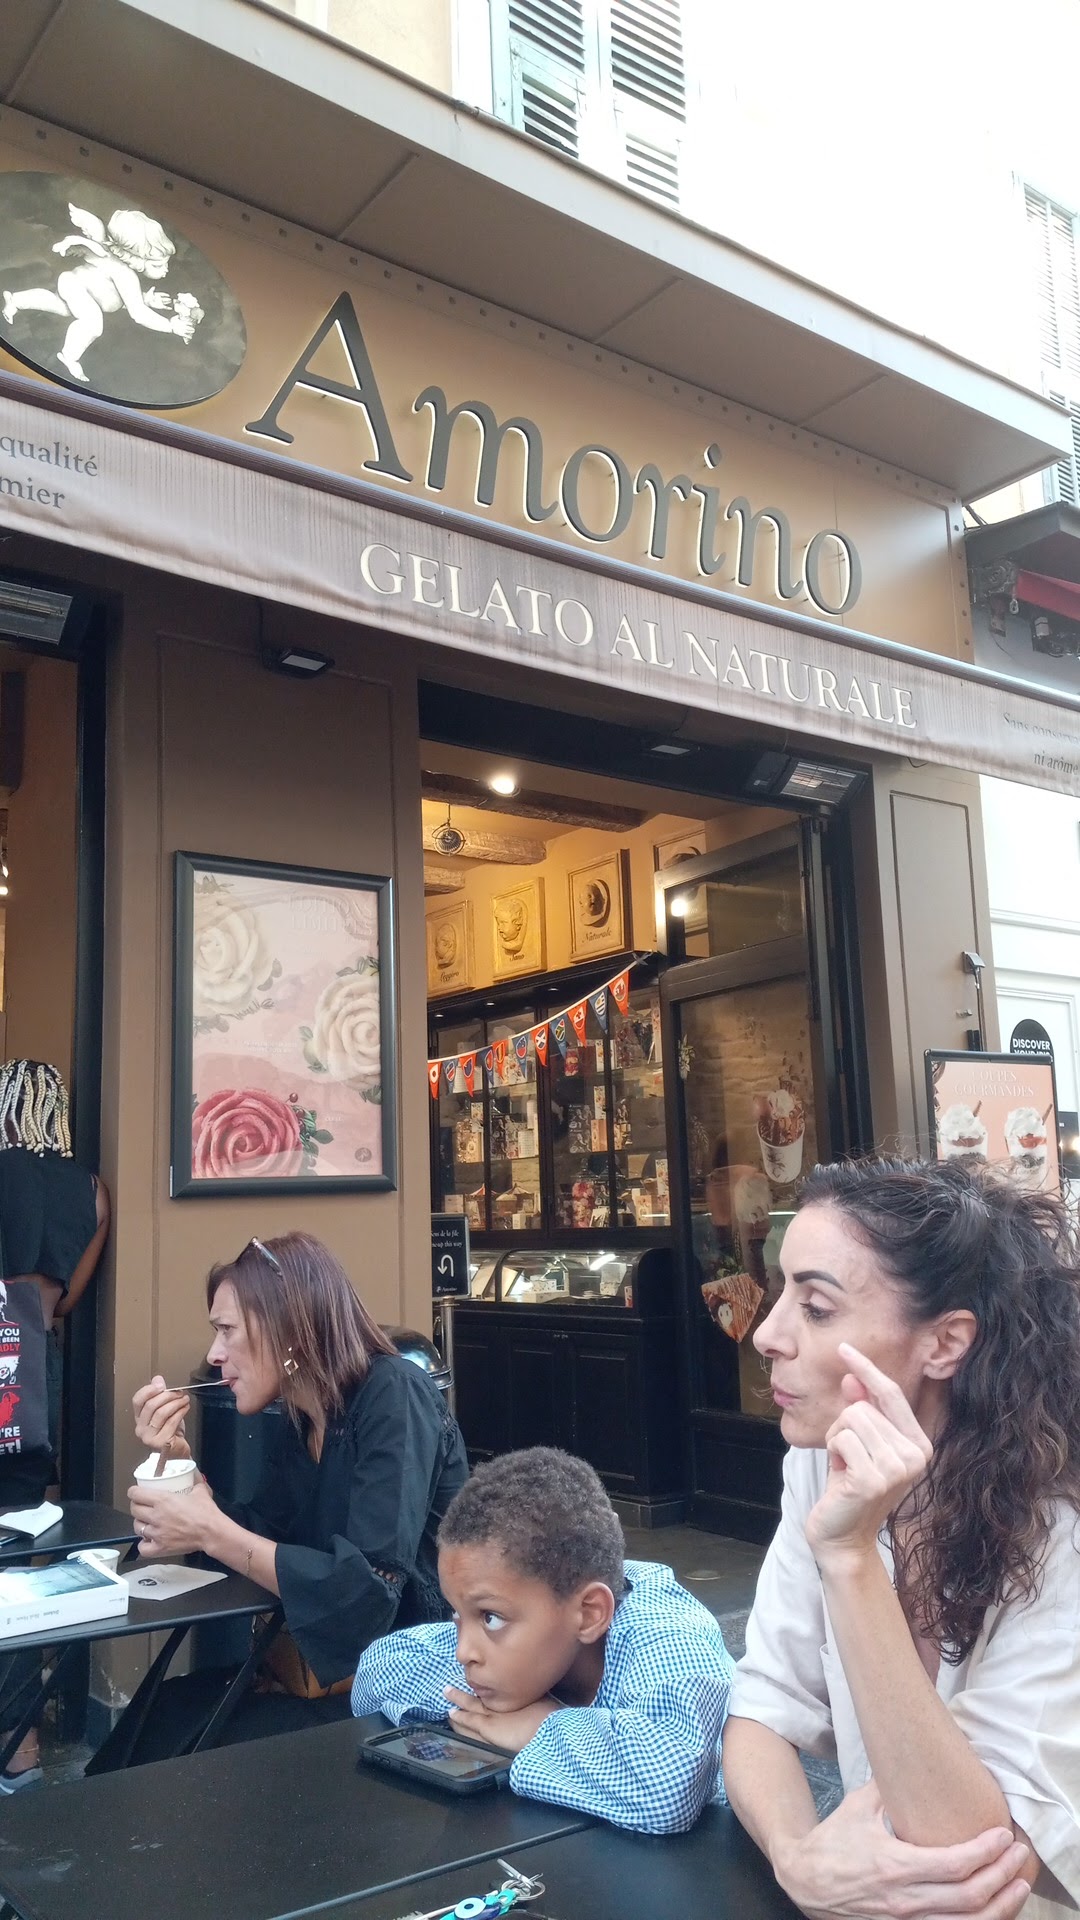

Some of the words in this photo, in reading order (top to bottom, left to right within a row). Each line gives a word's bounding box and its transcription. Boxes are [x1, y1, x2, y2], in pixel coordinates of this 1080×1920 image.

[0, 436, 98, 477] qualité
[242, 291, 862, 616] Amorino
[359, 542, 595, 647] GELATO
[610, 614, 675, 670] AL
[681, 630, 918, 730] NATURALE
[1034, 750, 1045, 766] ni
[1012, 1038, 1051, 1051] DISCOVER
[954, 1083, 1035, 1097] GOURMANDES
